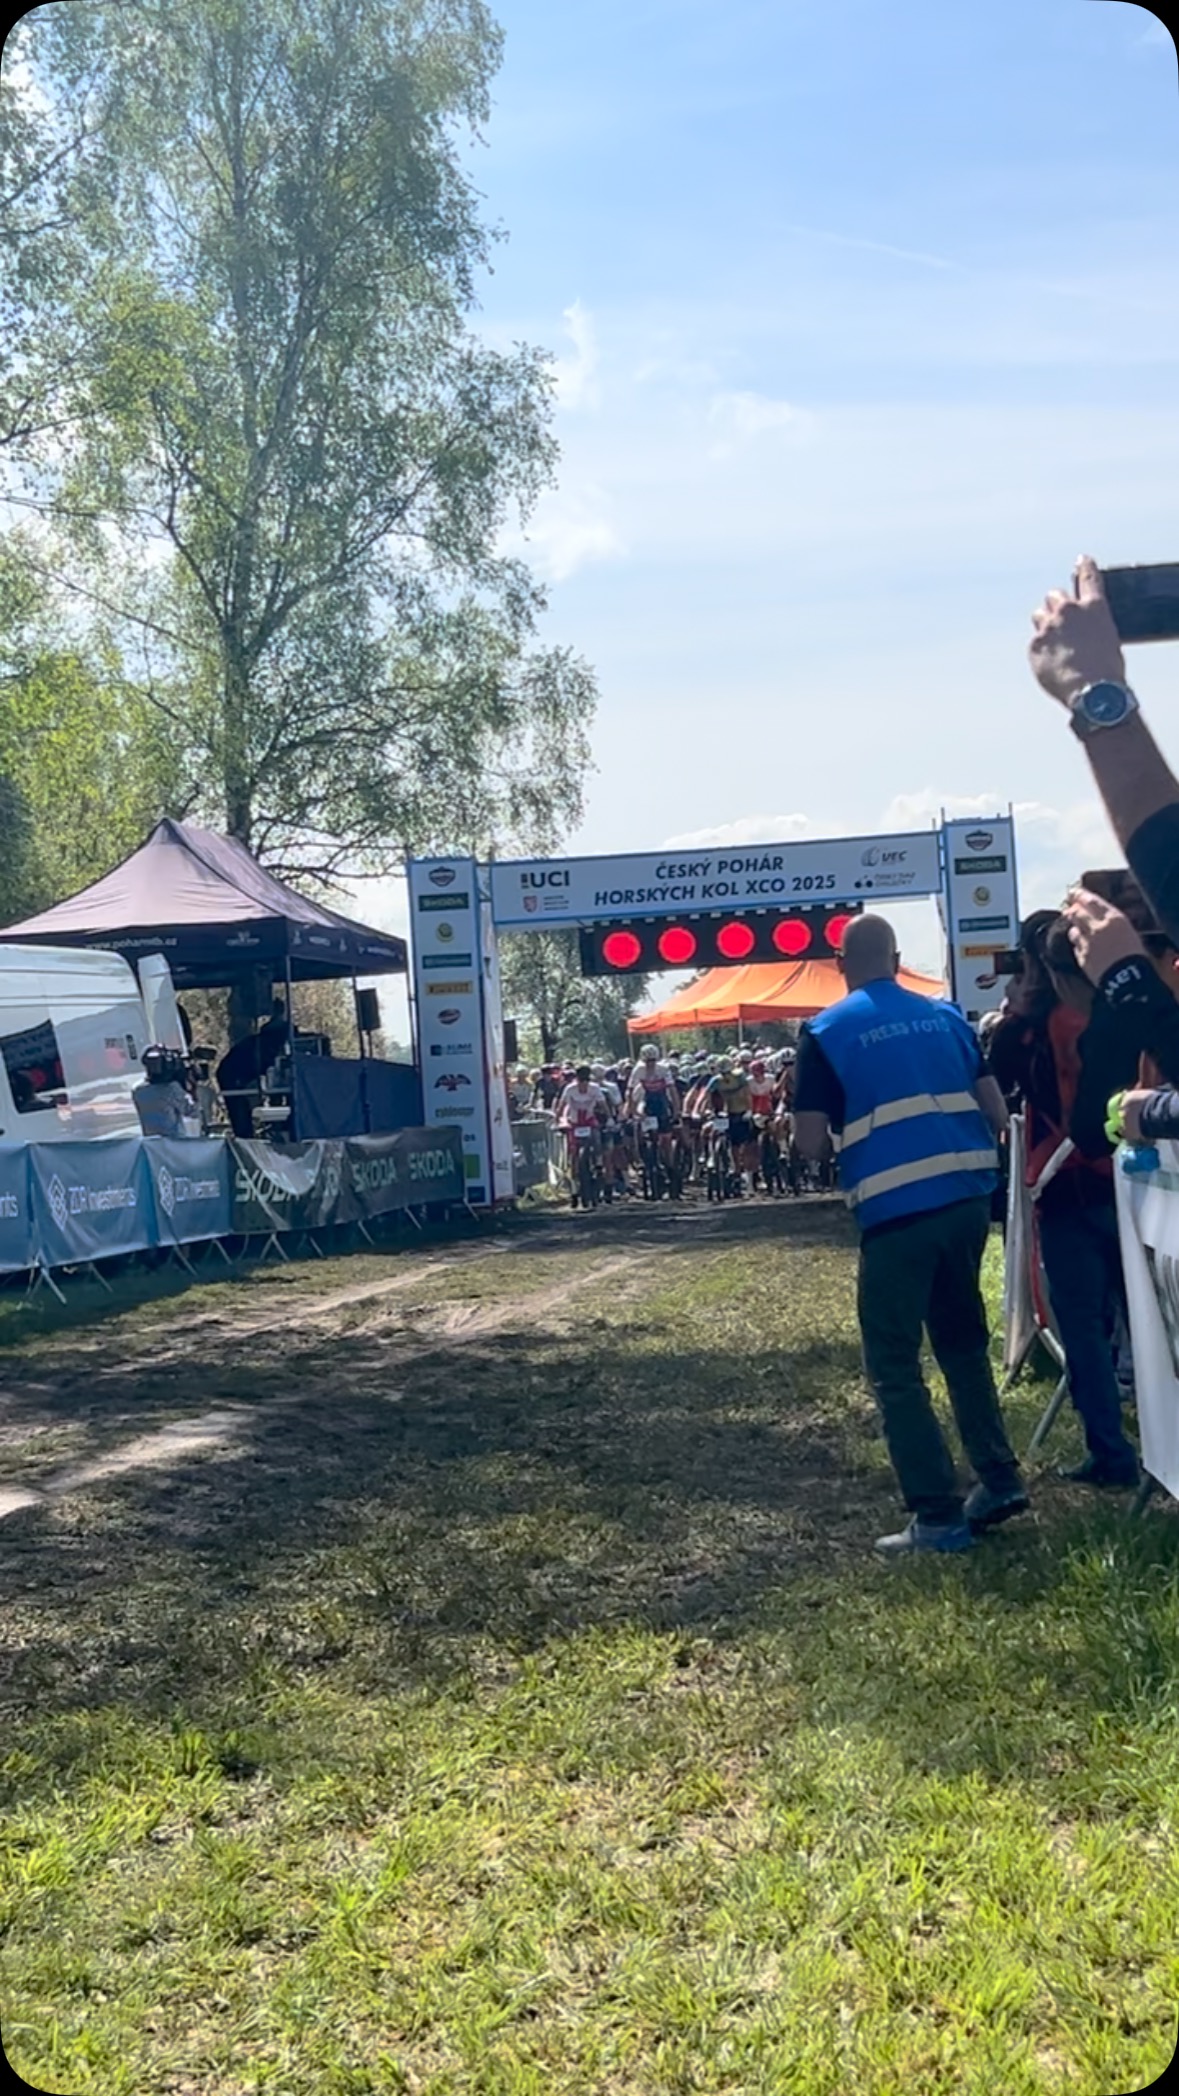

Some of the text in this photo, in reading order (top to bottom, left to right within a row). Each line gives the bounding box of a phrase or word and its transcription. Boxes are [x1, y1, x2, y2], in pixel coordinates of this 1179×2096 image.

[530, 870, 570, 888] UCI
[655, 853, 784, 880] ČESKÝ POHÁR
[594, 874, 836, 906] HORSKÝCH KOL XCO 2025
[859, 1023, 909, 1049] PRESS
